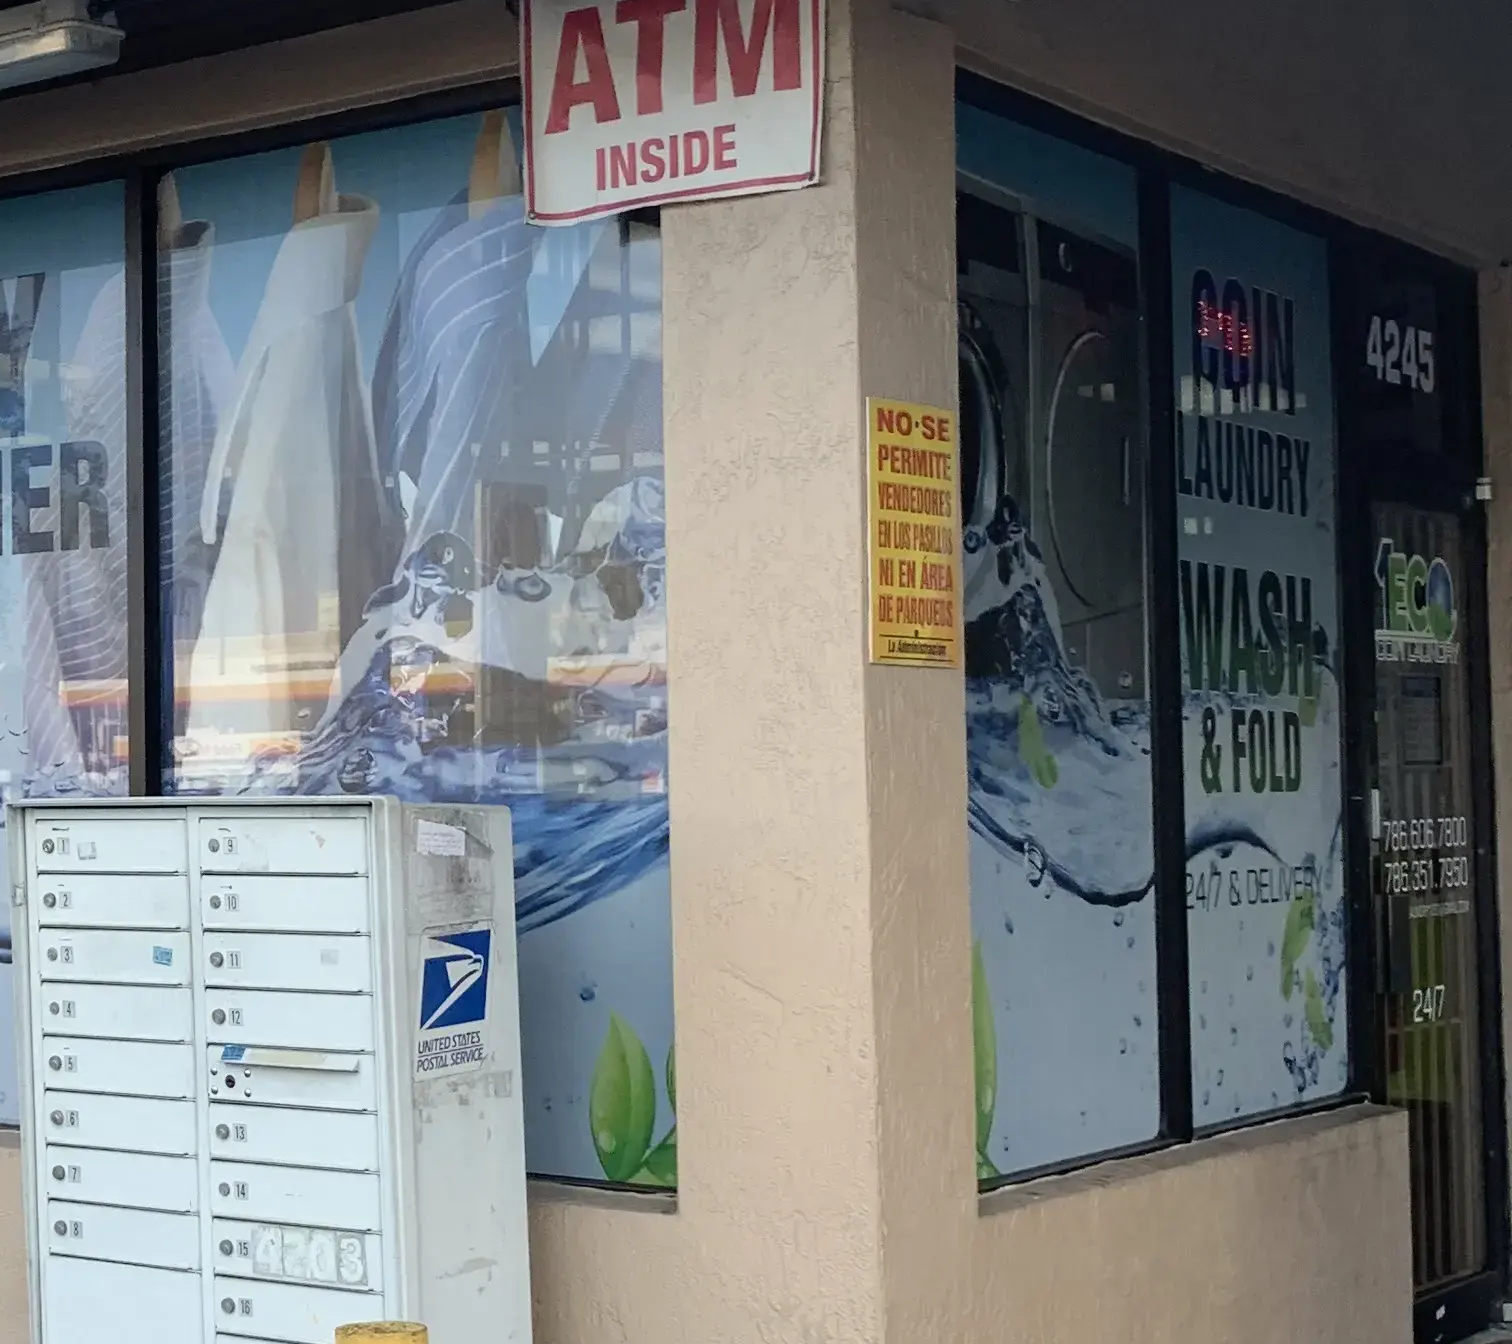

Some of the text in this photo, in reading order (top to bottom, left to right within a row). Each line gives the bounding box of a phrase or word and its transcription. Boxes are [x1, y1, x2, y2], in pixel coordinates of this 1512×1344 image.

[596, 124, 738, 191] INSIDE
[1191, 268, 1295, 416] COIN
[1366, 315, 1434, 393] 4245
[877, 408, 951, 442] NO SE
[878, 444, 952, 481] PERMITE
[1177, 410, 1310, 517] LAUNDRY
[878, 481, 952, 518] VENDEDORES
[878, 520, 891, 548] EN
[894, 520, 911, 551] LOS
[879, 558, 894, 587] NI
[899, 559, 916, 588] EN
[879, 595, 893, 622] DE
[1179, 559, 1315, 698] WASH
[1200, 706, 1222, 794] &
[1231, 708, 1301, 794] FOLD
[1229, 870, 1242, 906] &
[1246, 865, 1323, 905] DELIVERY
[227, 896, 237, 910] 10
[229, 953, 239, 967] 11
[231, 1011, 241, 1024] 12
[1413, 984, 1445, 1023] 24/7
[418, 1030, 481, 1055] UNITED STATES
[416, 1047, 484, 1073] POSTAL SERVICE
[235, 1126, 245, 1140] 13
[236, 1184, 246, 1198] 14
[238, 1242, 249, 1256] 15
[240, 1299, 251, 1315] 16
